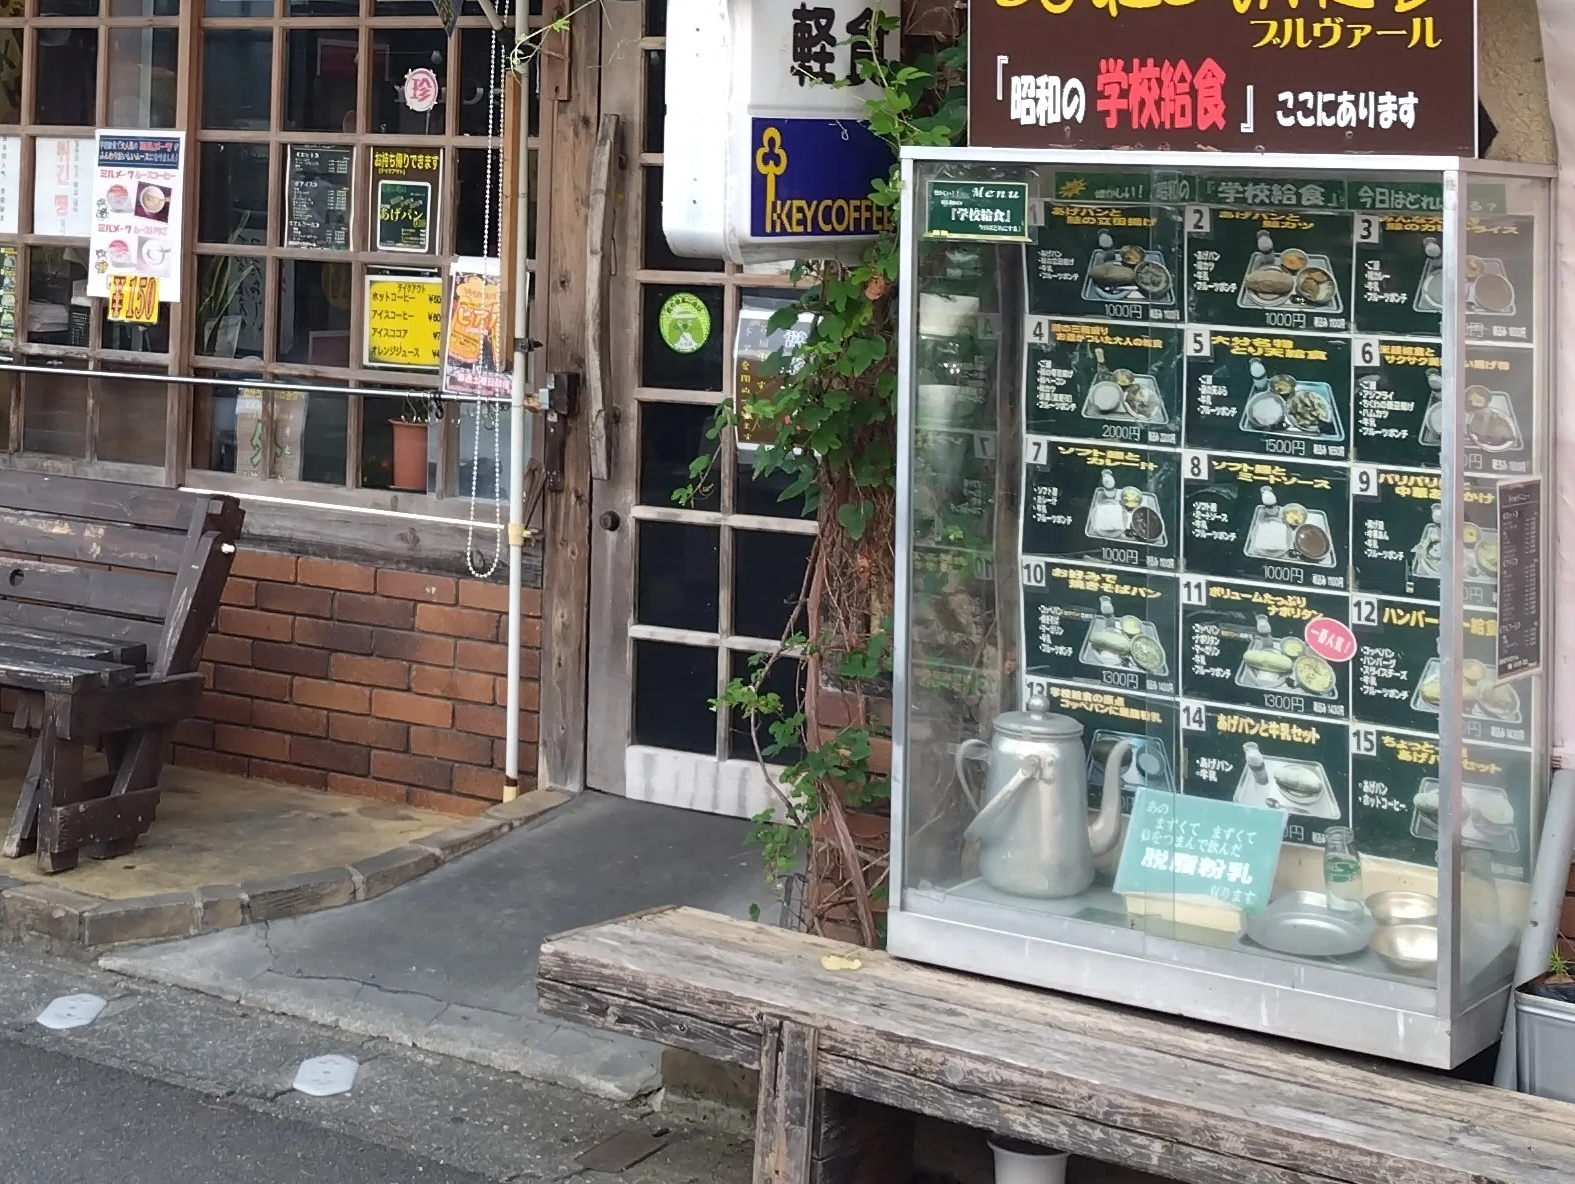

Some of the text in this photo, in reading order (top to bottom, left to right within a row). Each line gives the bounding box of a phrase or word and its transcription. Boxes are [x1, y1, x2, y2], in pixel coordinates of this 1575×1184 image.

[1250, 17, 1443, 50] ブルヴァール
[790, 2, 888, 87] 軽食
[1276, 91, 1419, 130] ここにあります
[374, 152, 438, 170] お持ち帰りできます
[972, 186, 1021, 199] Menu
[1193, 209, 1204, 229] 2
[1360, 219, 1372, 240] 3
[111, 276, 157, 321] ¥150
[372, 291, 415, 302] ホットコーヒー
[371, 309, 415, 320] アイスコーヒー
[1105, 304, 1142, 318] 1000円
[1265, 313, 1305, 328] 1000円
[371, 327, 408, 338] アイスココア
[1033, 322, 1044, 341] 4
[371, 342, 420, 357] オレンジジュース
[1193, 334, 1204, 353] 5
[1361, 343, 1373, 364] 6
[1102, 425, 1140, 440] 2000円
[1032, 442, 1042, 462] 7
[1264, 439, 1305, 455] 1500円
[1190, 456, 1202, 477] 8
[1238, 472, 1331, 489] ミートソース
[1358, 471, 1370, 492] 9
[1101, 548, 1138, 565] 1000円
[1024, 564, 1044, 583] 10
[1264, 566, 1304, 583] 1000円
[1183, 581, 1203, 603] 11
[1209, 587, 1307, 607] ボリュームたっぷり
[1267, 605, 1324, 620] ナポリタン
[1353, 600, 1375, 622] 12
[1102, 671, 1138, 689] 1300円
[1263, 694, 1304, 713] 1300円
[1183, 707, 1204, 727] 14
[1217, 714, 1321, 744] あげパンと牛乳セット
[1353, 730, 1375, 753] 15
[1147, 800, 1169, 815] あの
[1155, 816, 1257, 845] まずくて まずくて
[1141, 847, 1254, 885] 脱脂粉乳
